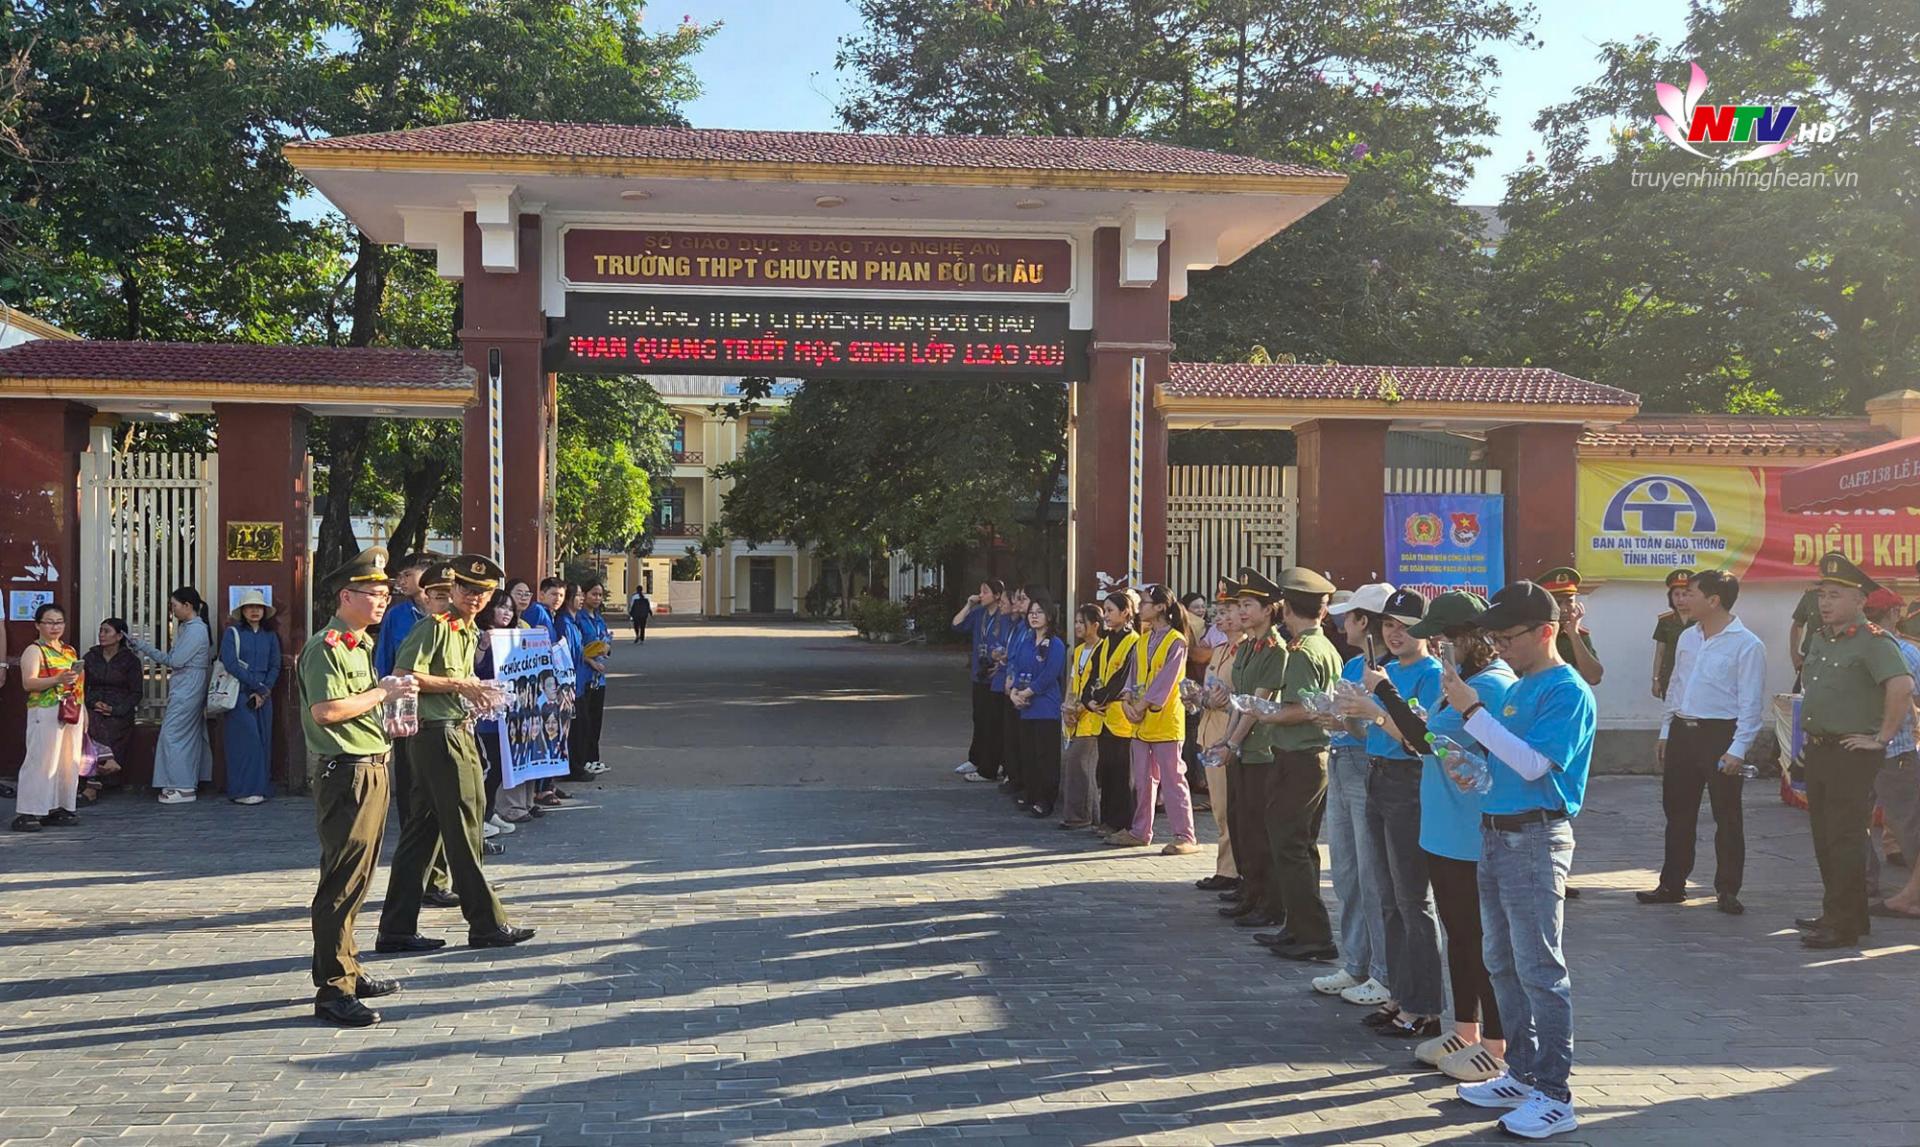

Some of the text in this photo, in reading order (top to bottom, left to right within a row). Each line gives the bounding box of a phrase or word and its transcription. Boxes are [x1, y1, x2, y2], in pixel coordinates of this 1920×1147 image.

[738, 237, 779, 255] DỤC
[788, 239, 803, 252] &
[861, 239, 902, 256] TẠO
[970, 241, 1000, 256] AN
[594, 250, 1044, 287] TRƯỜNG THPT CHUYÊN PHAN BỘI CHÂU
[1592, 535, 1726, 550] BAN AN TOÀN GIAO THÔNG
[1793, 522, 1863, 567] ĐIỀU
[1623, 550, 1695, 567] TỈNH NGHỆ AN
